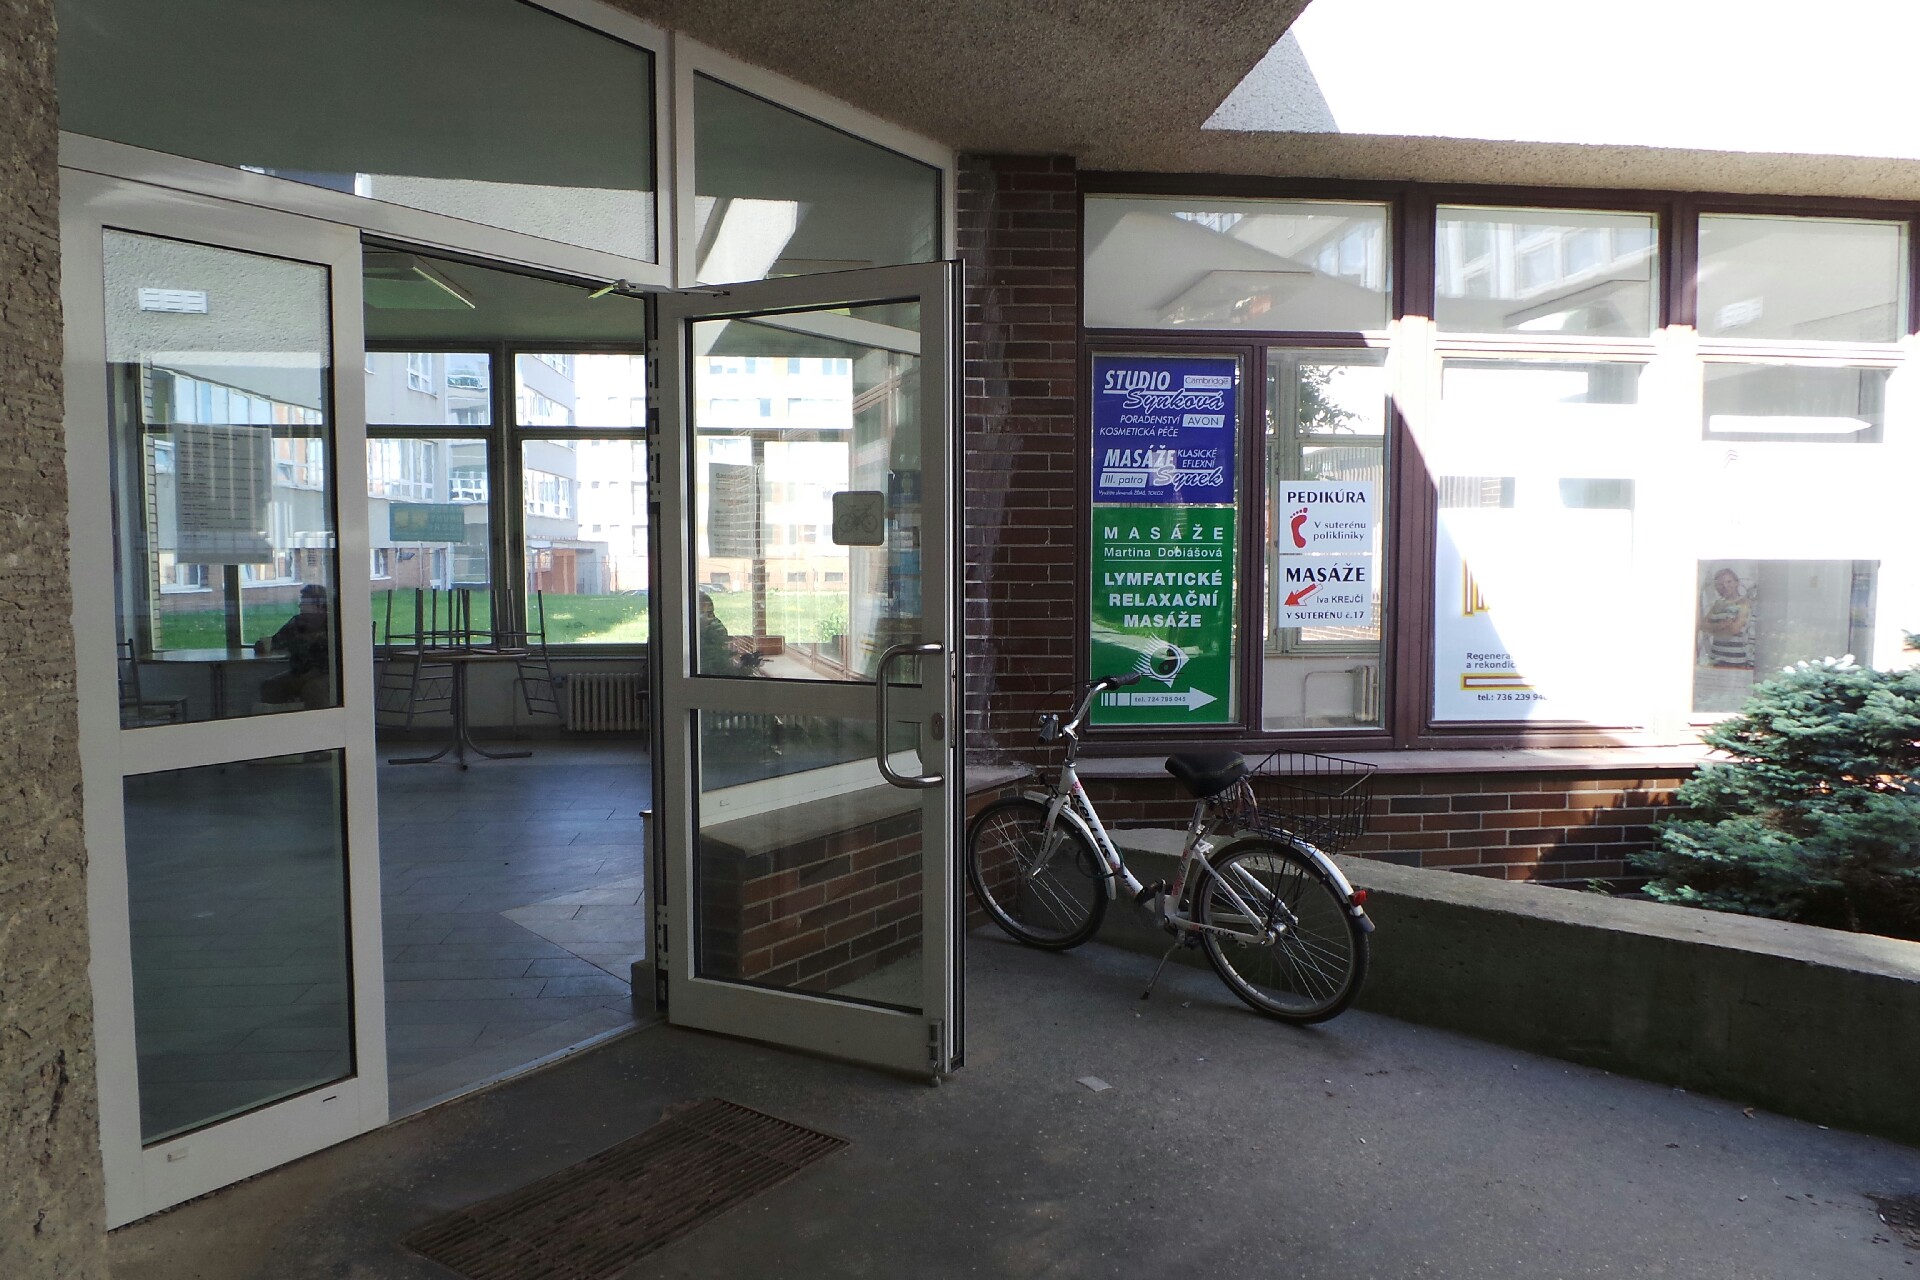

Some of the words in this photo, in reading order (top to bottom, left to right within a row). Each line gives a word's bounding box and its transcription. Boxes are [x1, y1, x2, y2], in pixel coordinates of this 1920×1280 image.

[1104, 370, 1170, 390] STUDIO
[1185, 376, 1229, 386] Cambridge
[1122, 387, 1225, 414] Synková
[1120, 414, 1181, 424] PORADENSTVÍ
[1187, 417, 1219, 426] AVON
[1099, 425, 1155, 436] KOSMETICKÁ
[1157, 426, 1179, 437] PÉČE
[1104, 444, 1176, 468] MASÁŽE
[1177, 448, 1218, 458] KLASICKÉ
[1182, 458, 1216, 468] EFLEXNÍ
[1104, 474, 1116, 484] III.
[1118, 475, 1143, 486] patro
[1153, 465, 1224, 492] Synek
[1287, 489, 1366, 503] PEDIKÚRA
[1313, 521, 1322, 529] V
[1324, 521, 1366, 529] suterénu
[1104, 523, 1224, 540] MASÁŽE
[1313, 532, 1365, 542] polikliniky
[1104, 547, 1151, 557] Martina
[1158, 547, 1222, 557] Dobiášová
[1104, 569, 1223, 586] LYMFATICKÉ
[1286, 563, 1366, 583] MASÁŽE
[1109, 590, 1218, 607] RELAXAČNÍ
[1316, 595, 1329, 604] Iva
[1331, 593, 1364, 604] KREJČÍ
[1123, 611, 1202, 628] MASÁŽE
[1295, 611, 1343, 620] SUTERÉNU
